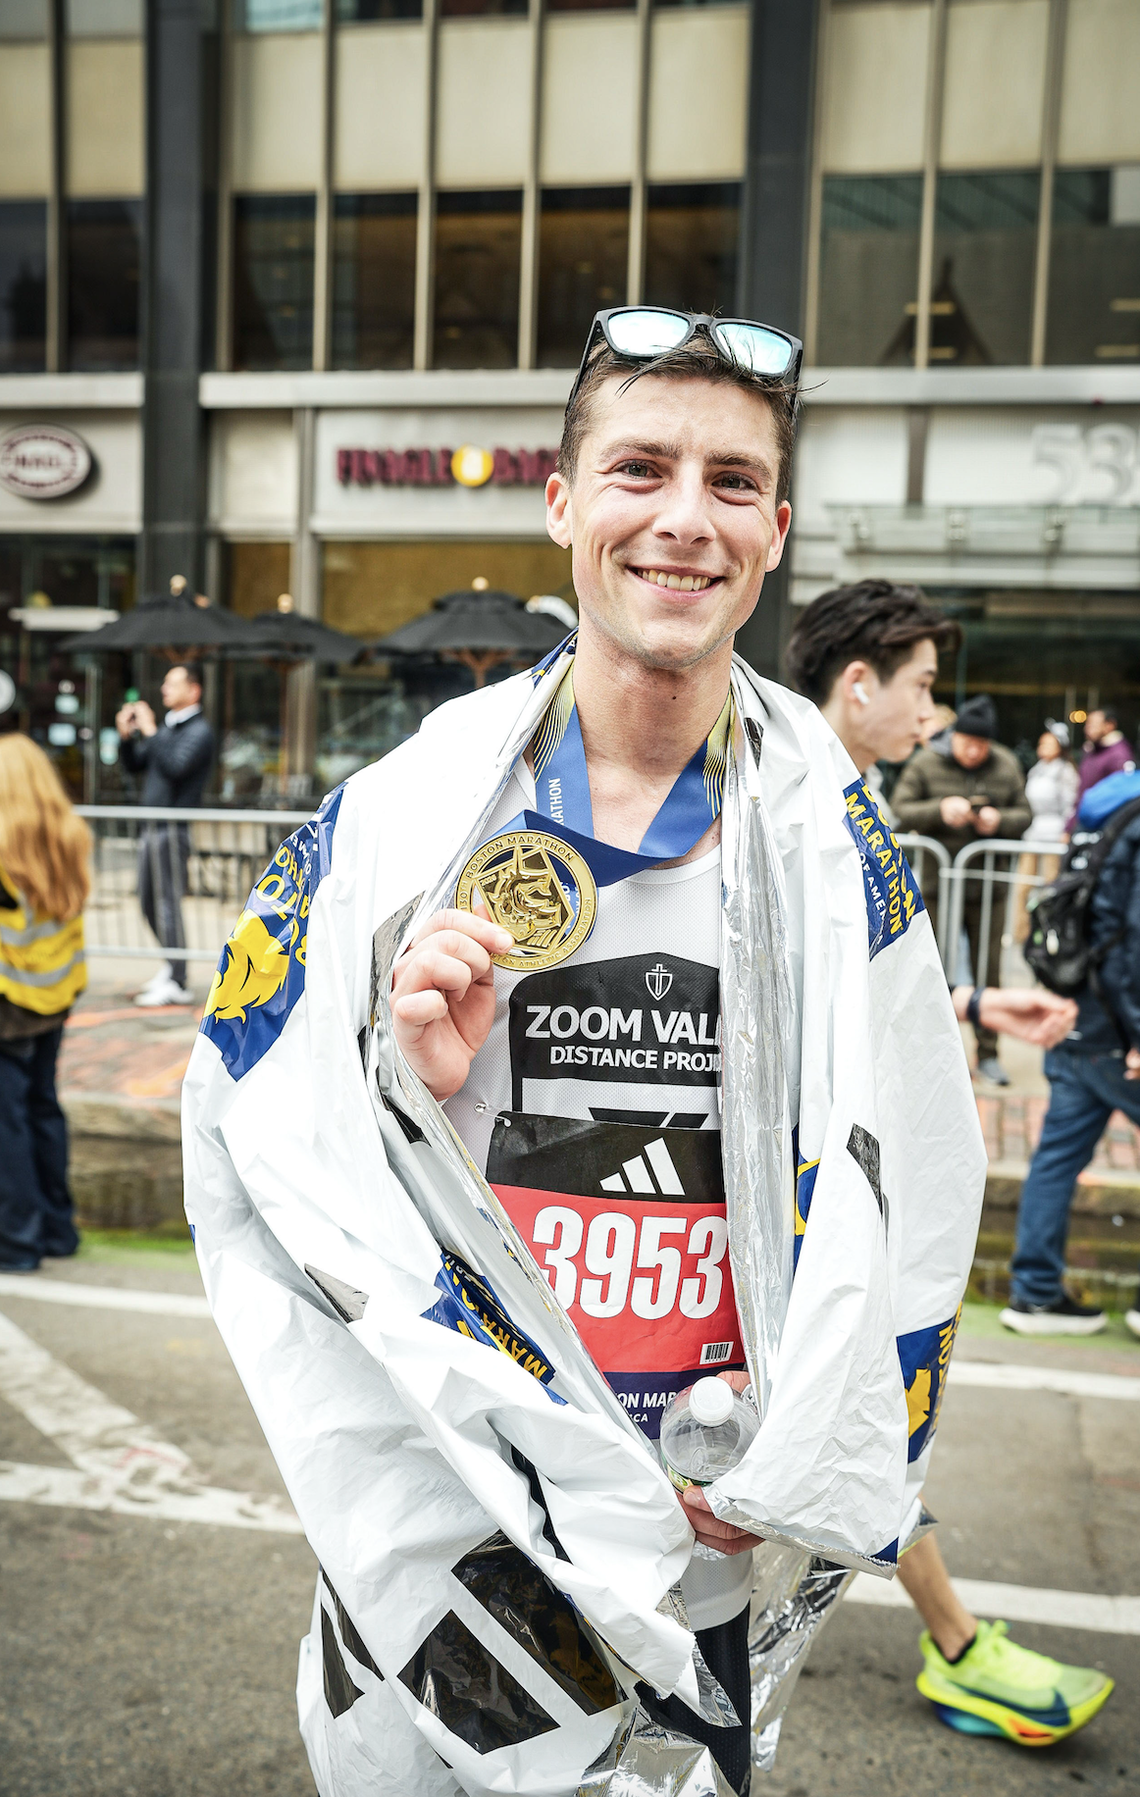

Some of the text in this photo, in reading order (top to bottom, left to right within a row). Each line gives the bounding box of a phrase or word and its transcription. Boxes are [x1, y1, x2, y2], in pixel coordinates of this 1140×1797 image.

[465, 841, 504, 879] BOSTON
[507, 835, 575, 862] MARATHON
[845, 792, 903, 935] MARATHON
[562, 896, 592, 954] ASSOCIATION
[525, 1005, 643, 1041] ZOOM
[550, 1045, 658, 1070] DISTANCE
[532, 1205, 728, 1320] 3953
[615, 1392, 640, 1408] ON
